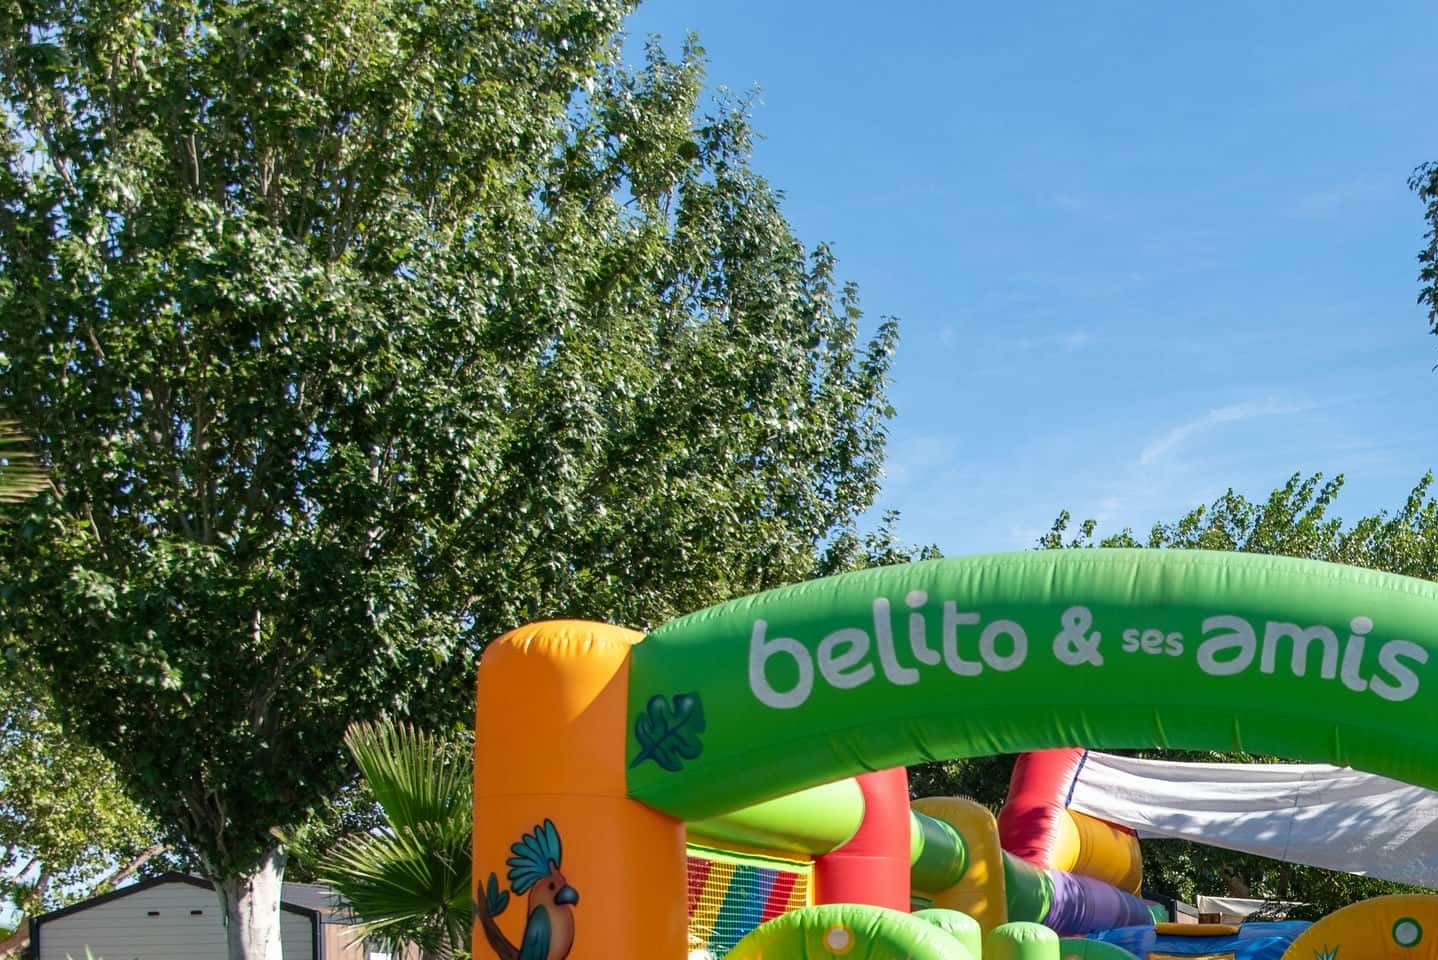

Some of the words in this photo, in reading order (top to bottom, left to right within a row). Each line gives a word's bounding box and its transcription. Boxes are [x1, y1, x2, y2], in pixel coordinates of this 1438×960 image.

[749, 590, 1028, 709] belito
[1053, 606, 1103, 666] &
[1121, 627, 1185, 657] ses
[1197, 616, 1430, 701] amis
